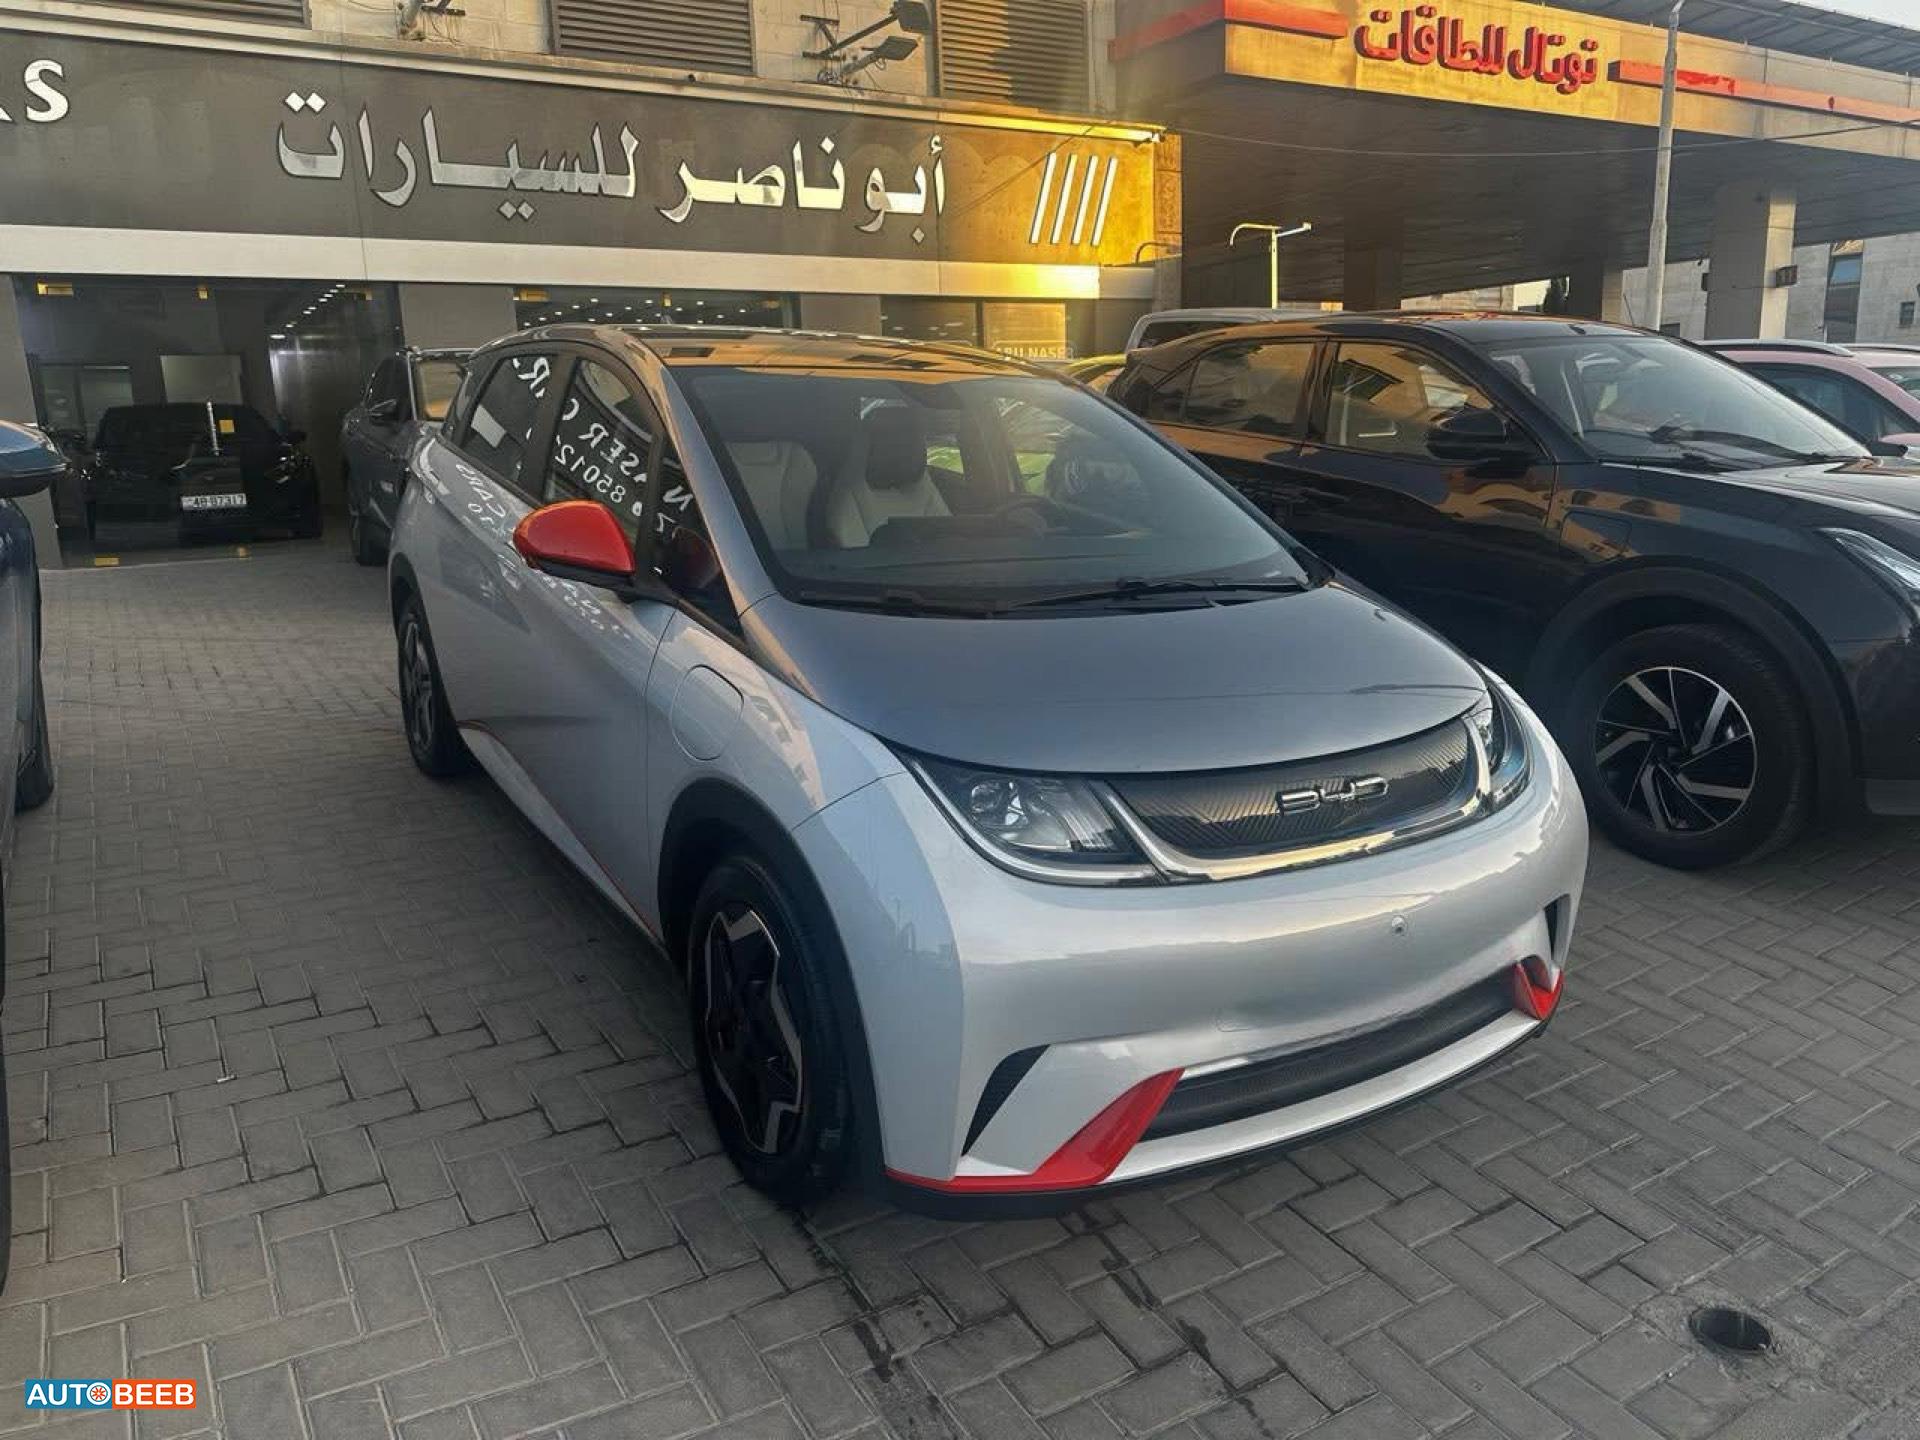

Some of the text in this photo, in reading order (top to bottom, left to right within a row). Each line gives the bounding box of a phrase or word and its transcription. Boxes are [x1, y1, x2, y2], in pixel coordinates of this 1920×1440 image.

[1353, 5, 1599, 94] توتال للطاقات
[0, 59, 70, 123] S
[276, 90, 946, 245] أبو ناصر للسيارات
[1277, 774, 1389, 815] BYD
